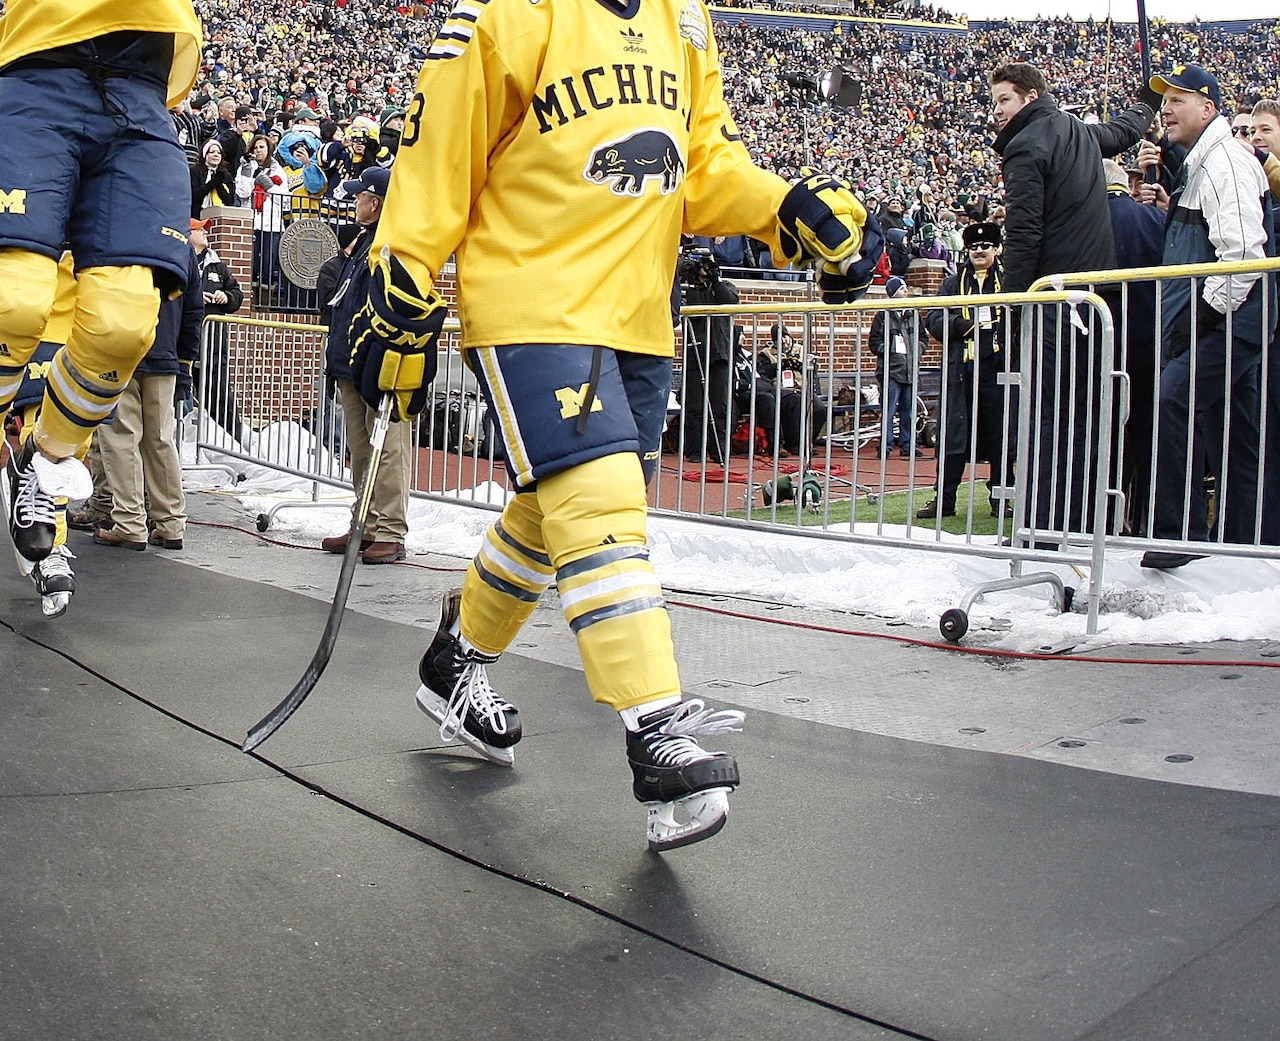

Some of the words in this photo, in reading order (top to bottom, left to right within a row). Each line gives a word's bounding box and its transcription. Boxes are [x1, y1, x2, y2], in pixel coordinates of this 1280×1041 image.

[623, 45, 648, 55] adidas
[533, 64, 690, 135] MICHIG
[28, 361, 51, 380] M
[554, 382, 604, 420] M
